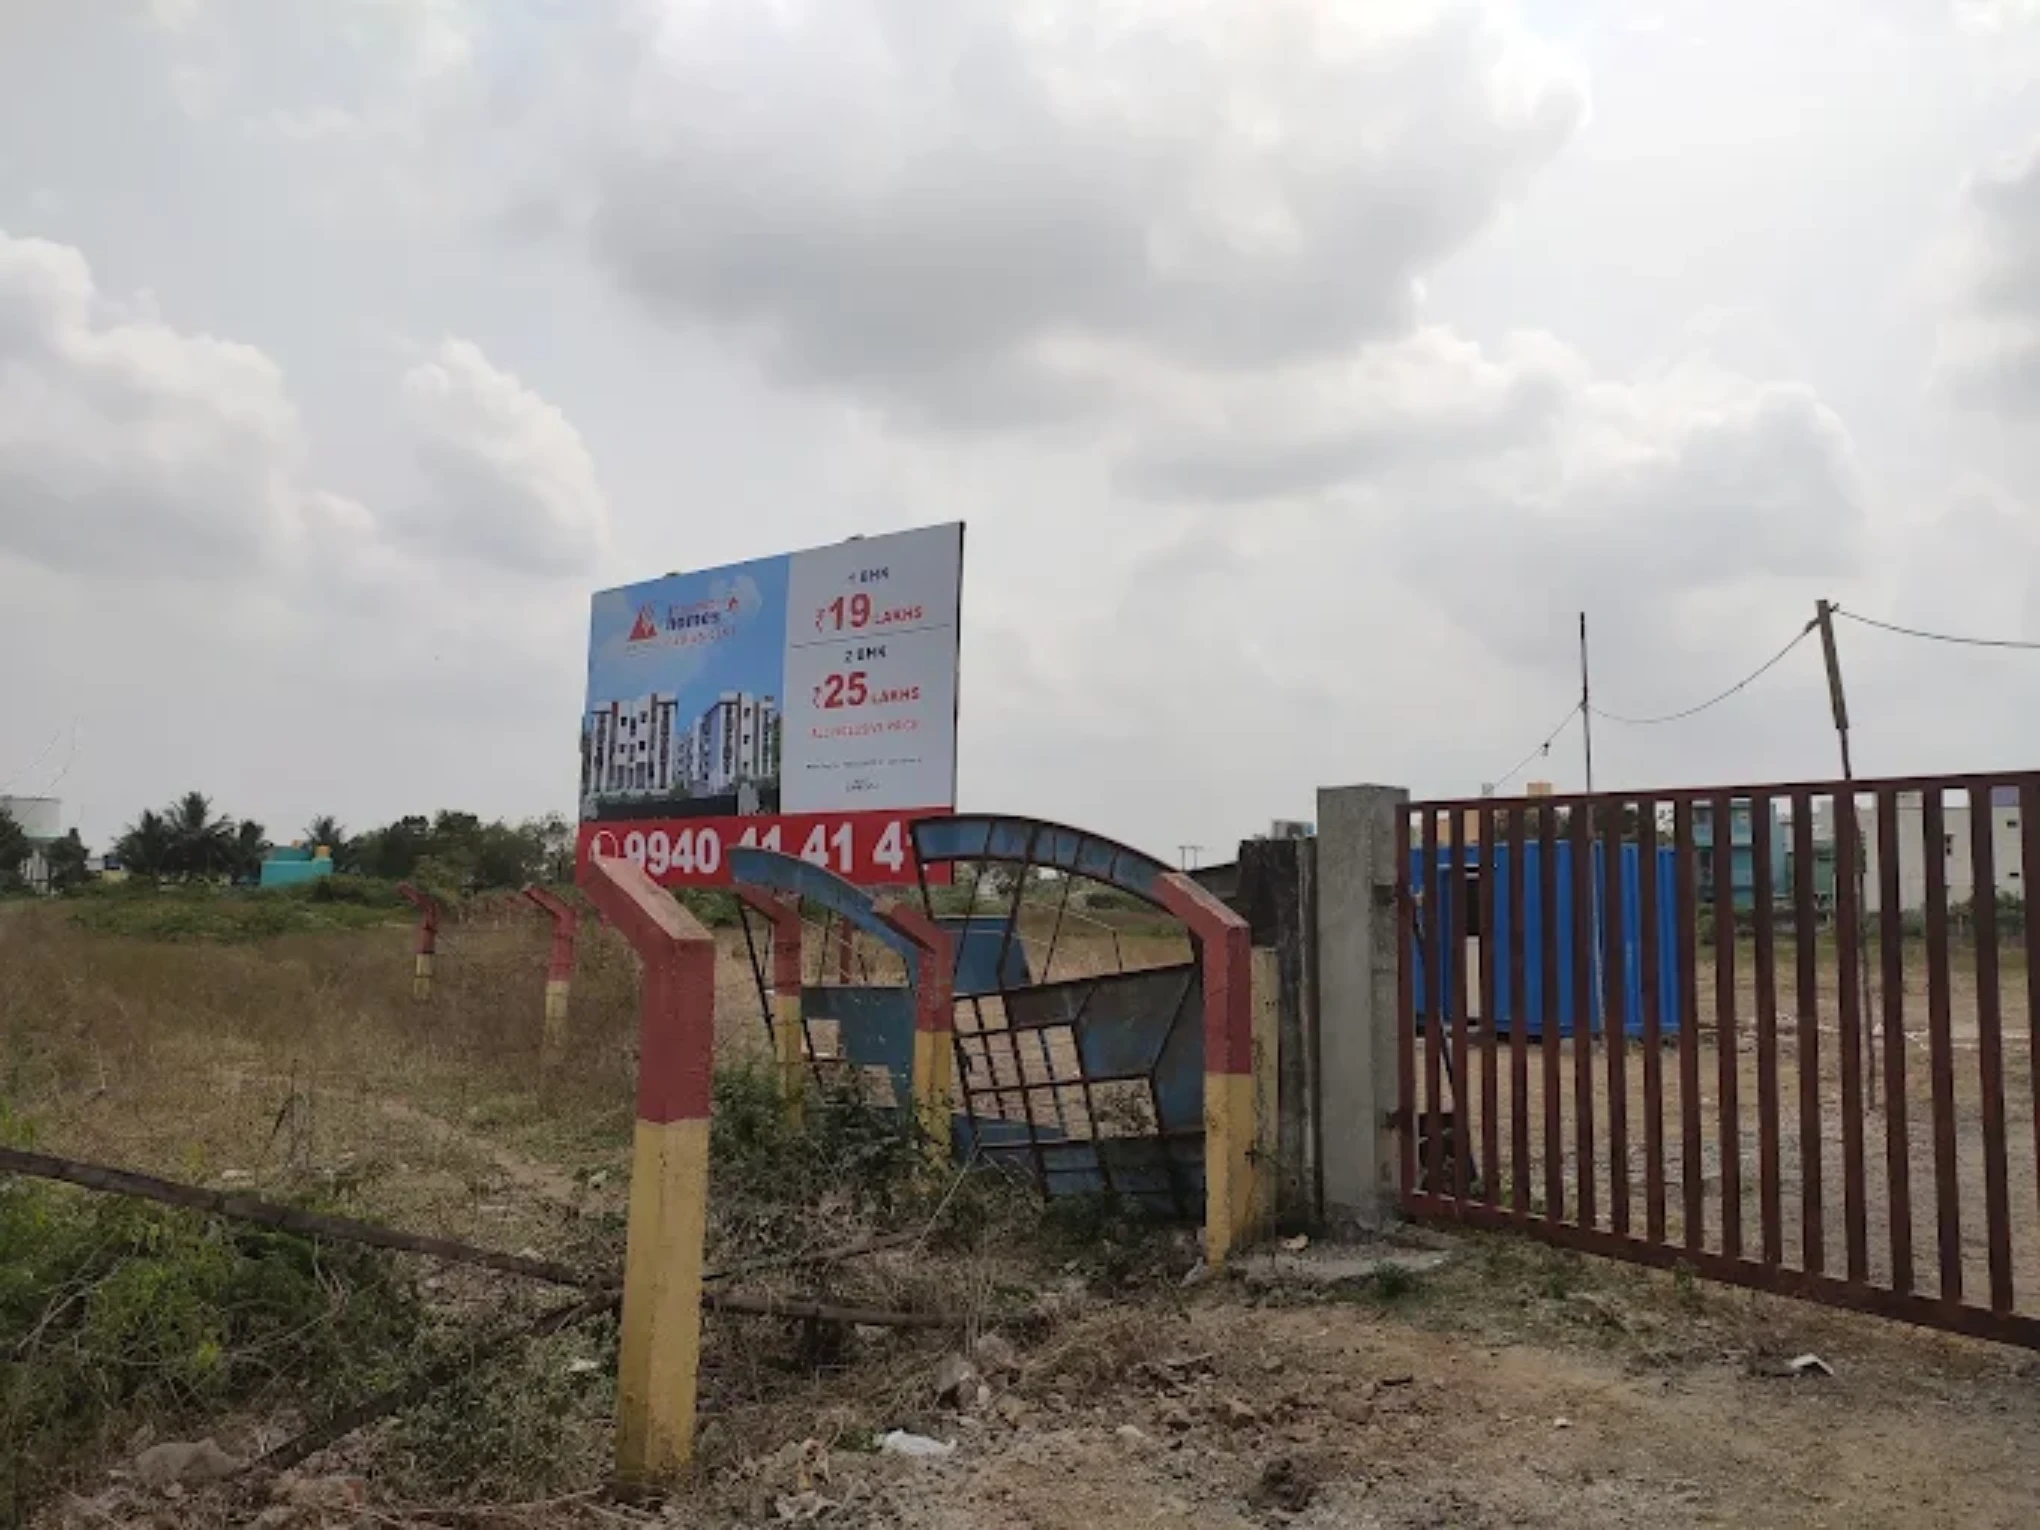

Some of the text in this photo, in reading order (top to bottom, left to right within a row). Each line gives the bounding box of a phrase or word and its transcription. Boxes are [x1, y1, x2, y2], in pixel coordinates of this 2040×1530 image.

[875, 605, 923, 625] LAKHS
[843, 650, 853, 664] 2
[871, 685, 921, 705] LAKHS
[623, 826, 721, 876] 9940
[800, 821, 854, 874] 41
